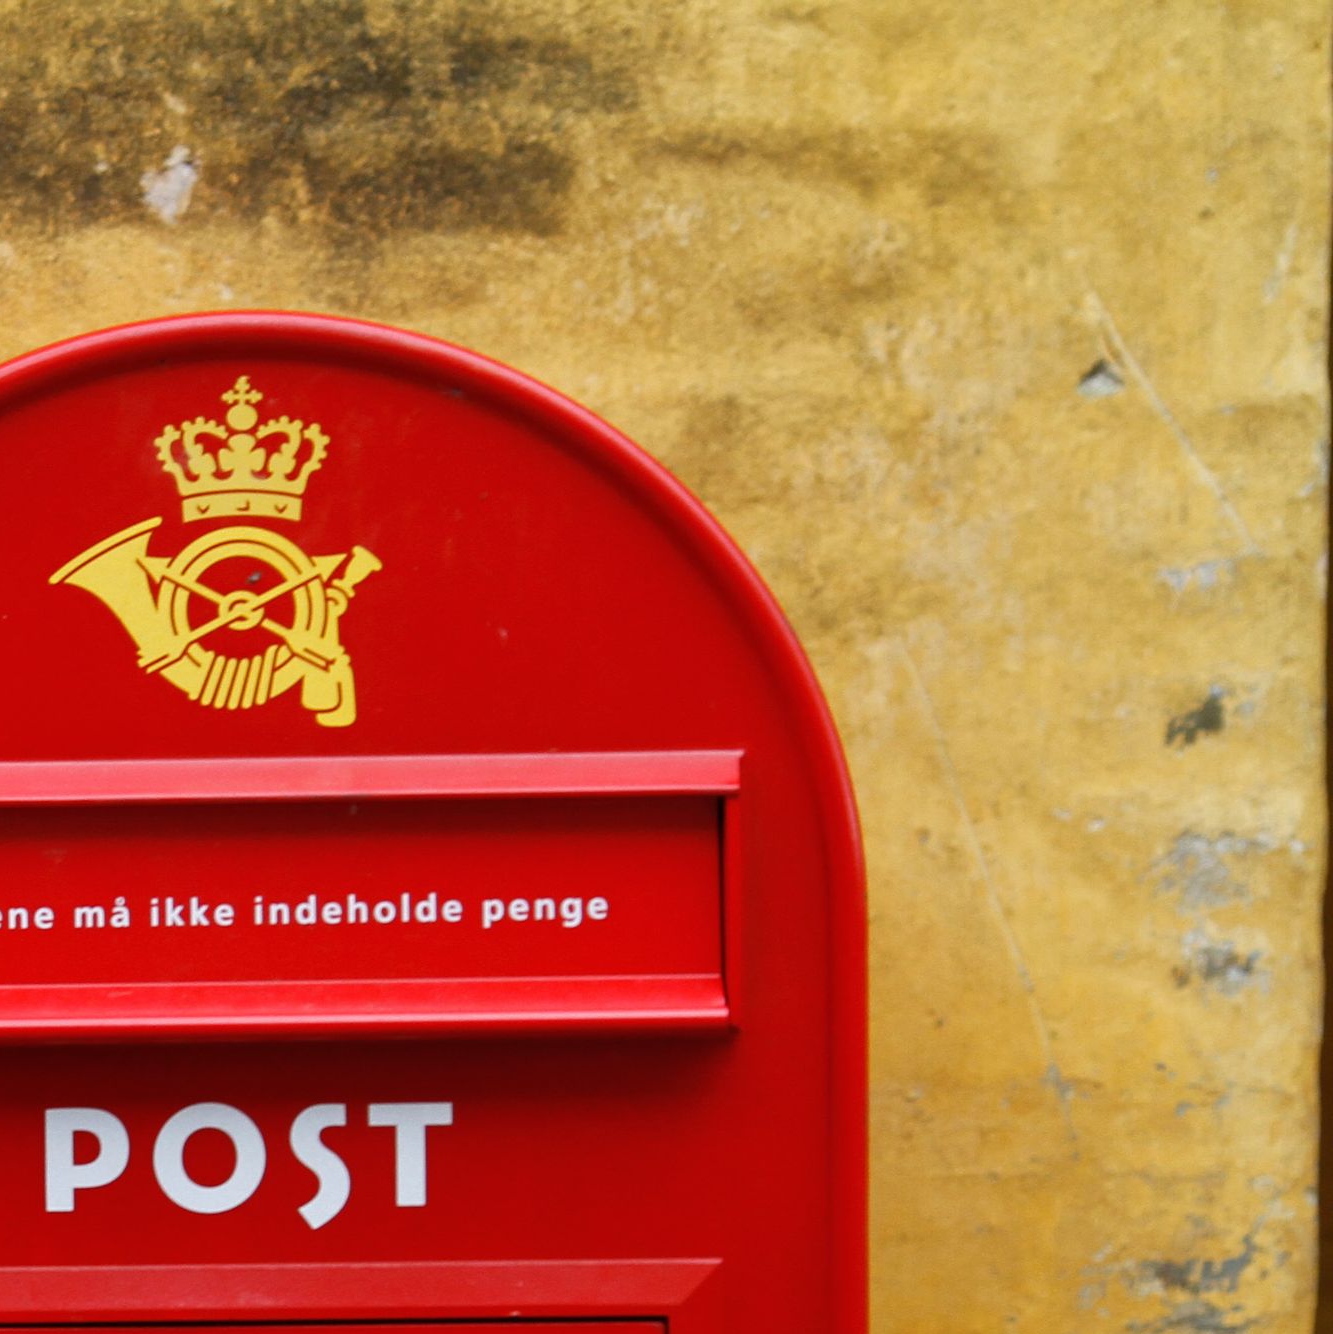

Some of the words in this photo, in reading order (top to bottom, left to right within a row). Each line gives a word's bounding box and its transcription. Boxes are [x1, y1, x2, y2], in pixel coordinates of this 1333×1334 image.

[74, 897, 130, 928] må
[150, 897, 234, 927] ikke
[254, 892, 462, 925] indeholde
[482, 897, 608, 928] penge
[45, 1102, 453, 1229] POST
